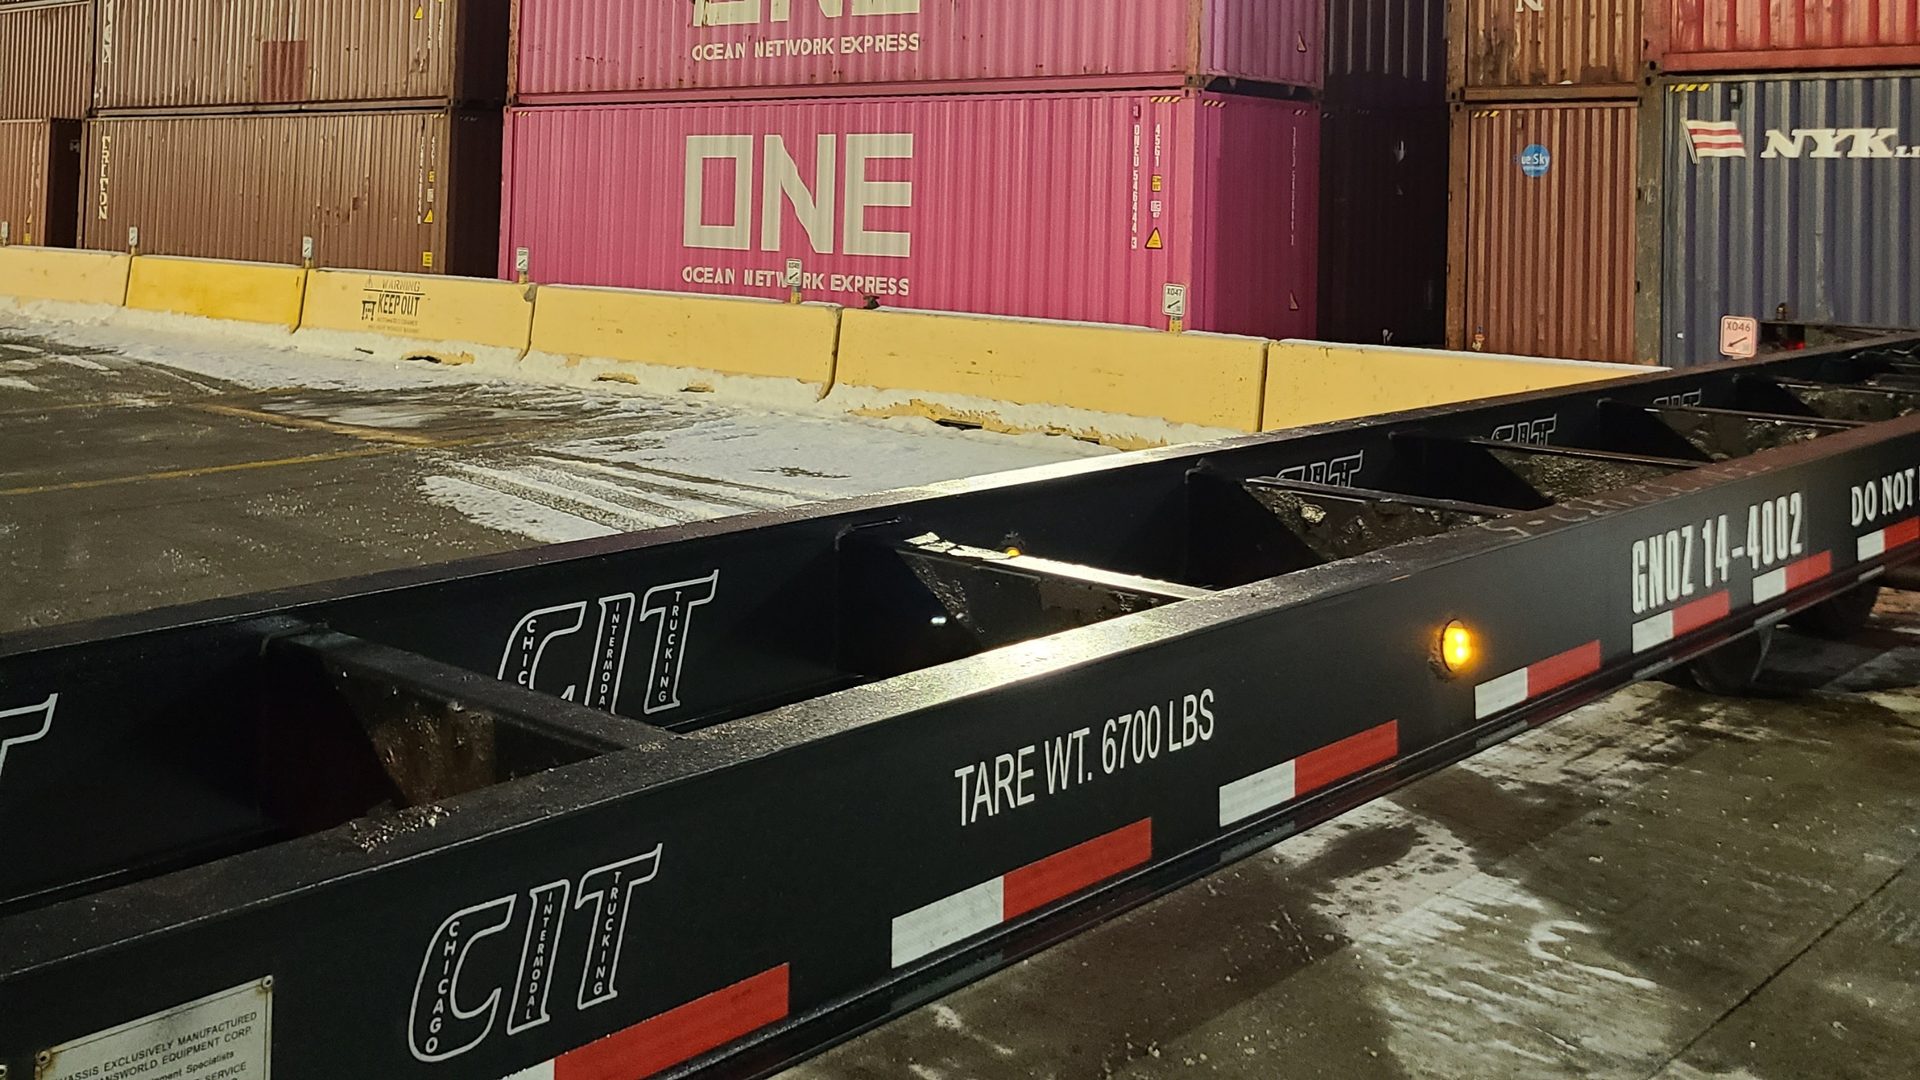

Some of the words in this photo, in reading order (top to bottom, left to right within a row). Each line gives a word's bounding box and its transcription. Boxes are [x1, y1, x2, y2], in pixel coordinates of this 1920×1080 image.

[691, 42, 746, 61] OCEAN
[755, 37, 835, 58] NETWORK
[840, 33, 920, 56] EXPRESS
[683, 133, 913, 257] ONE
[1760, 128, 1898, 158] NYK
[377, 293, 400, 315] KEEP
[401, 295, 420, 317] OUT
[682, 266, 735, 284] OCEAN
[744, 269, 824, 290] NETWRK
[830, 274, 910, 296] EXPRESS
[1851, 480, 1878, 527] DO
[1881, 467, 1915, 516] NOT
[1632, 524, 1694, 615] GNOZ
[1702, 492, 1803, 588] 14-4002
[517, 619, 537, 685] CHIC
[598, 601, 620, 709] INTERMODA
[658, 590, 682, 703] TRUCKING
[954, 744, 1035, 827] TARE
[1044, 727, 1093, 795] WT.
[1102, 704, 1161, 775] 6700
[1168, 687, 1215, 752] LBS
[408, 842, 663, 1063] CIT
[425, 920, 461, 1054] CHICAGO
[524, 890, 553, 1020] INTERMODAL
[593, 871, 622, 996] TRUCKING
[56, 1066, 99, 1080] ASSIS
[104, 1039, 173, 1072] EXCLUSIVELY
[178, 1011, 257, 1046] MANUFACTURED
[162, 1037, 220, 1065] EQUIPMENT
